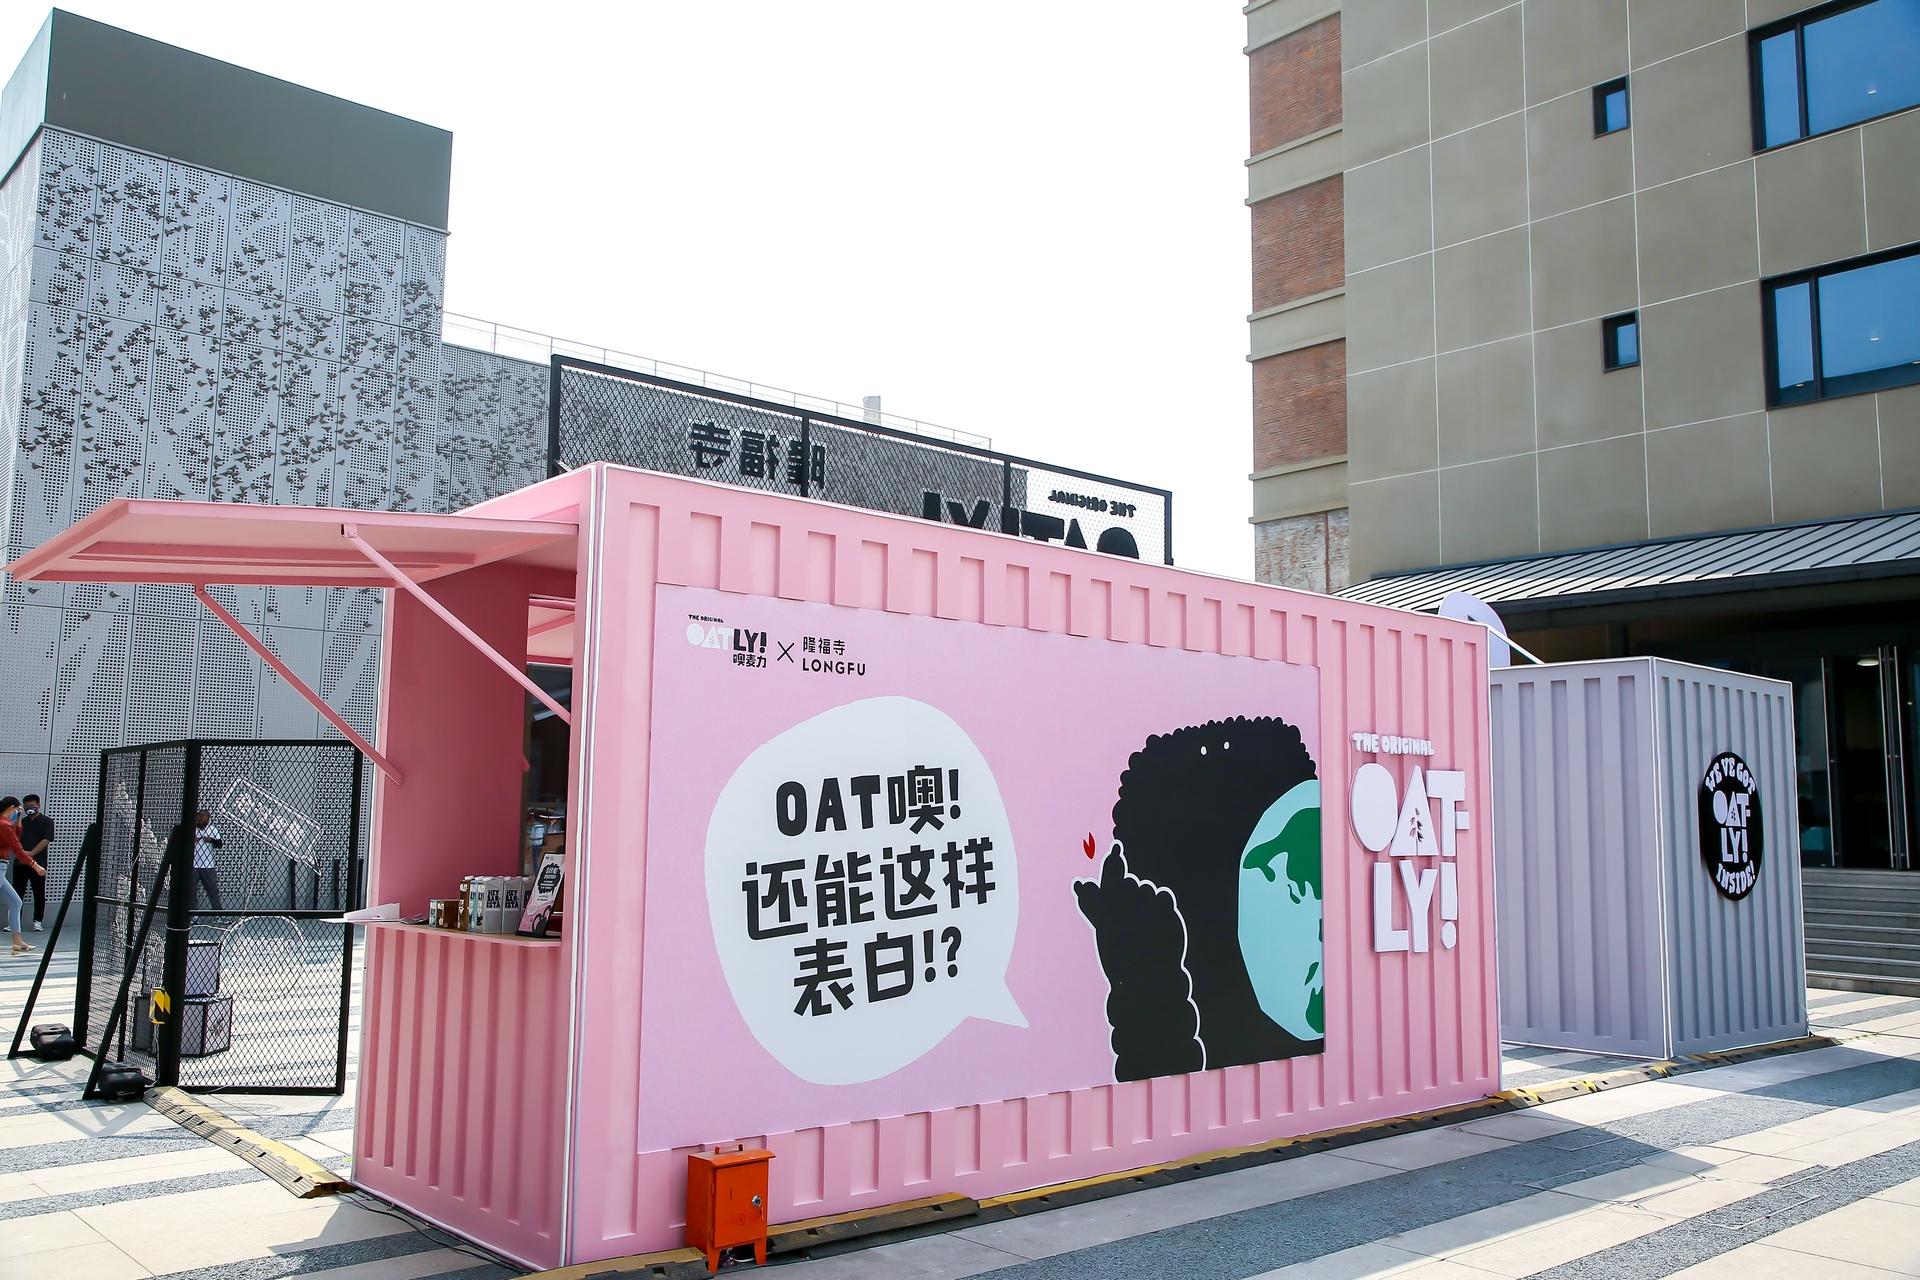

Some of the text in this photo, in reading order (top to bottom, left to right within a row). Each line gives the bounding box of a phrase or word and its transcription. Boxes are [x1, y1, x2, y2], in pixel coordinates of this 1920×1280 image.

[733, 653, 767, 668] 噢麦力
[803, 636, 845, 656] 隆福寺
[802, 658, 866, 676] LONGFU
[1352, 732, 1435, 757] THE ORIGINAL
[1736, 763, 1755, 795] GOT
[1721, 827, 1748, 863] LY!
[741, 837, 996, 940] 还能这样
[1716, 860, 1756, 895] INSIDE!
[1374, 860, 1458, 952] LY!
